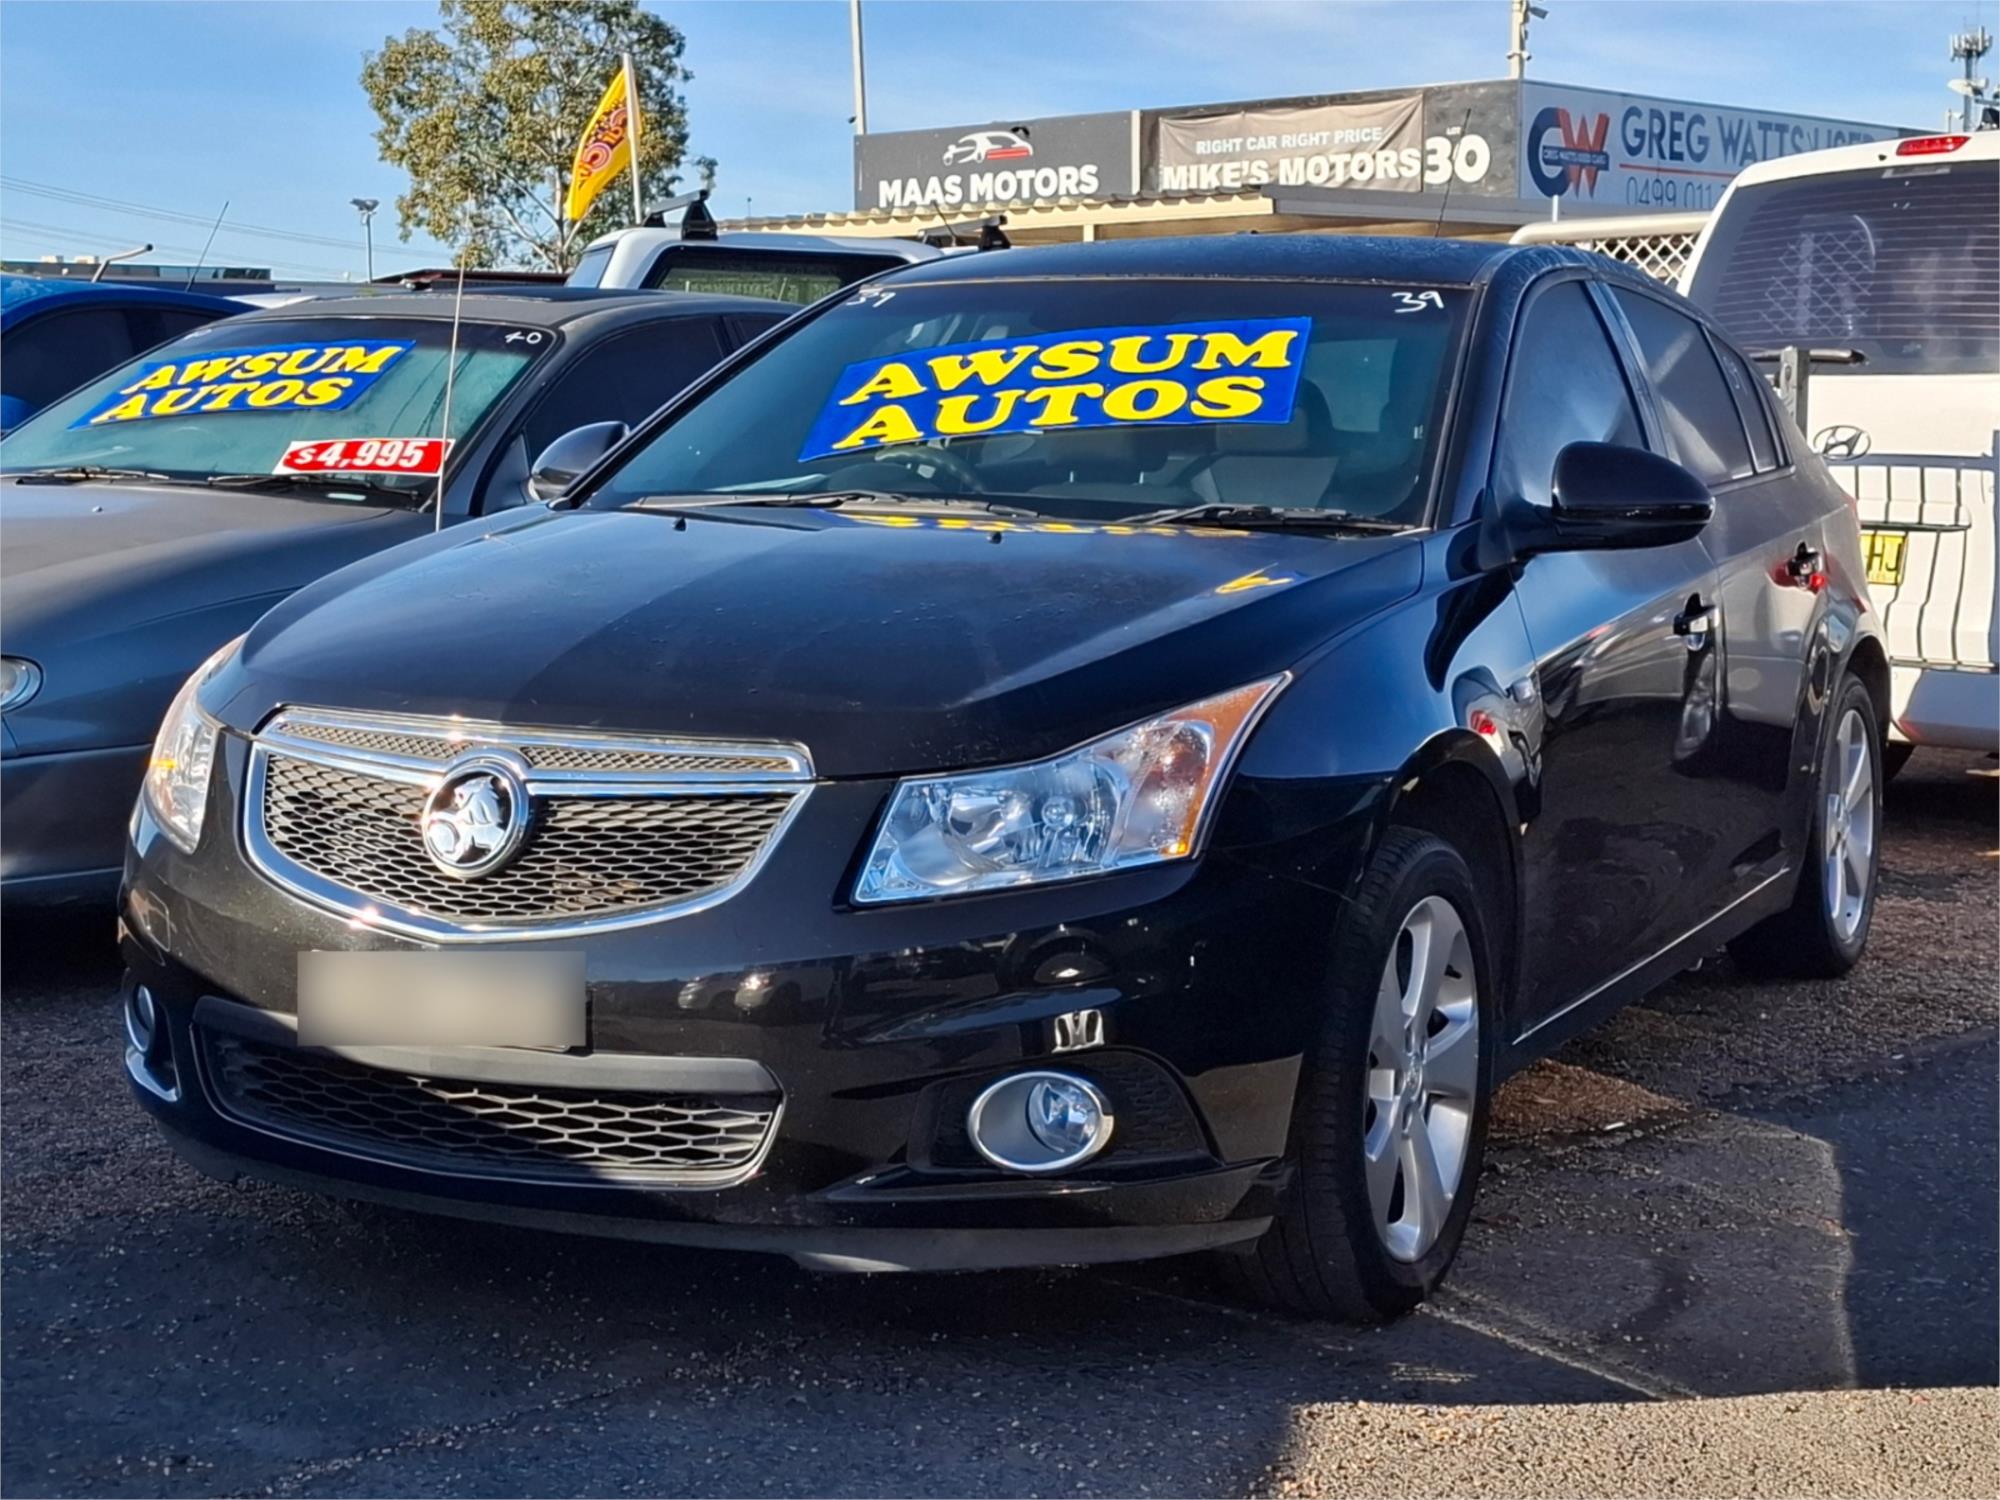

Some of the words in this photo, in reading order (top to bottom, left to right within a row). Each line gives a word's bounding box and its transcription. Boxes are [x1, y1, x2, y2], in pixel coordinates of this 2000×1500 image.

[1196, 138, 1243, 155] RIGHT
[1246, 135, 1277, 151] CAR
[1281, 131, 1330, 148] RIGHT
[1334, 127, 1383, 144] PRICE
[1621, 106, 1709, 162] GREG
[1162, 161, 1270, 191] MIKE'S
[1278, 148, 1421, 186] MOTORS
[1423, 134, 1491, 185] 30
[879, 175, 962, 207] MAAS
[970, 164, 1100, 202] MOTORS
[1626, 176, 1678, 209] 0499
[1391, 290, 1445, 313] 39
[119, 346, 402, 394] AWSUM
[840, 330, 1298, 405] AWSUM
[89, 377, 353, 423] AUTOS
[833, 375, 1266, 450] AUTOS
[294, 441, 428, 468] $4,995
